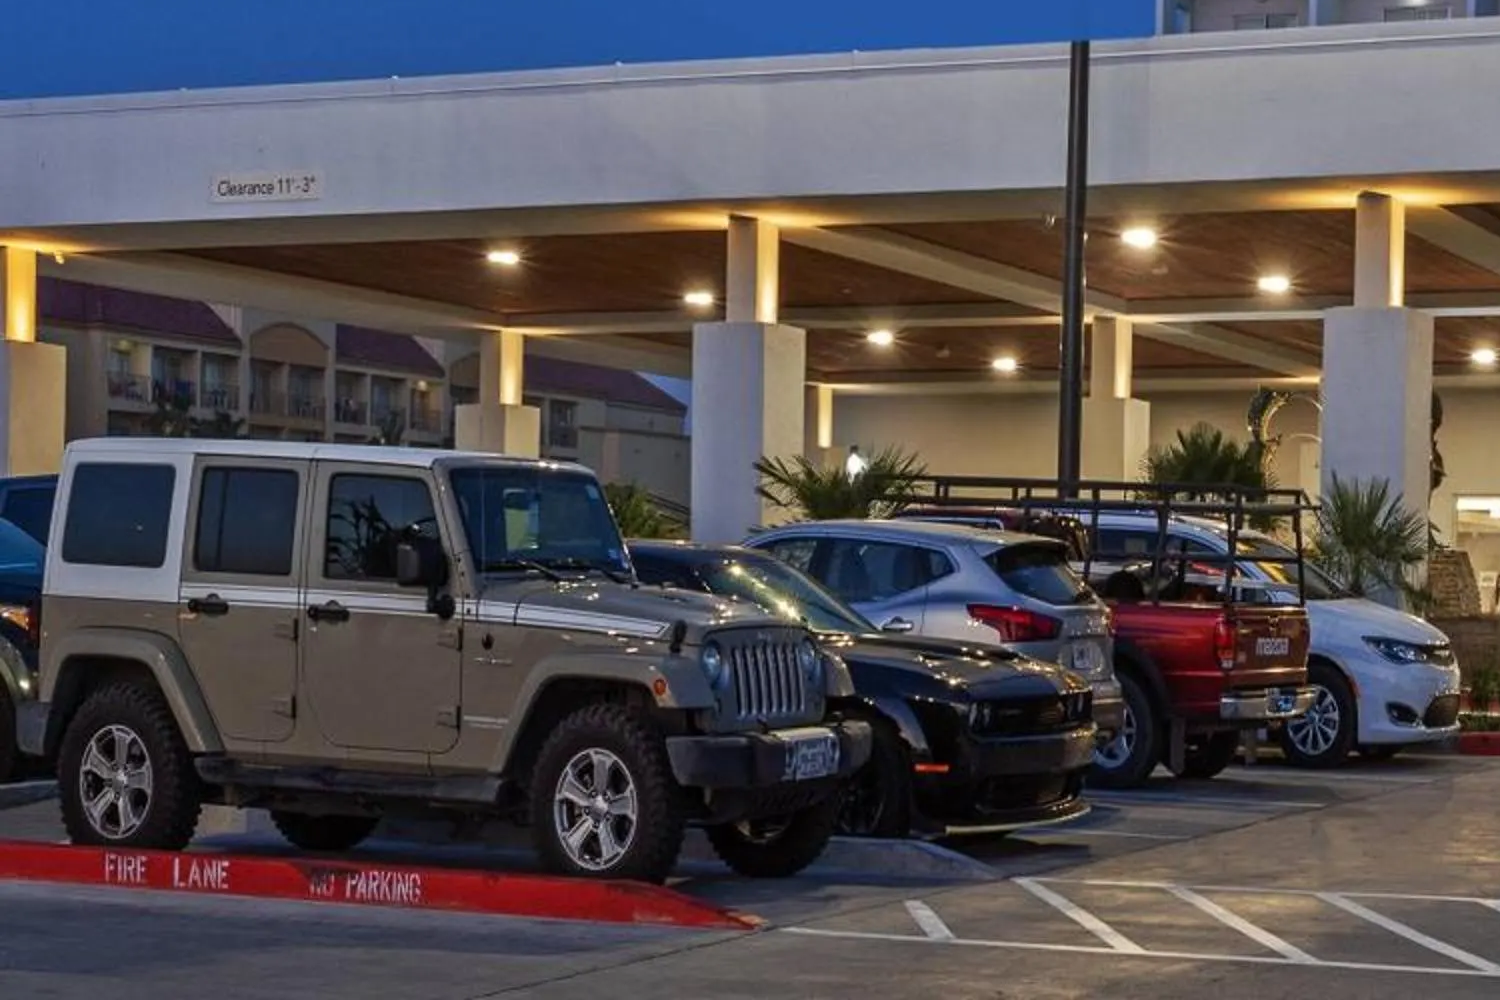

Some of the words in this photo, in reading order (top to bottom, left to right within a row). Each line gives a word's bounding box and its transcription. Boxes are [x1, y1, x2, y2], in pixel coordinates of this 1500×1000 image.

[217, 179, 275, 196] Clearance
[104, 852, 147, 883] FIRE
[173, 856, 230, 889] LANE
[345, 870, 421, 903] PARKING
